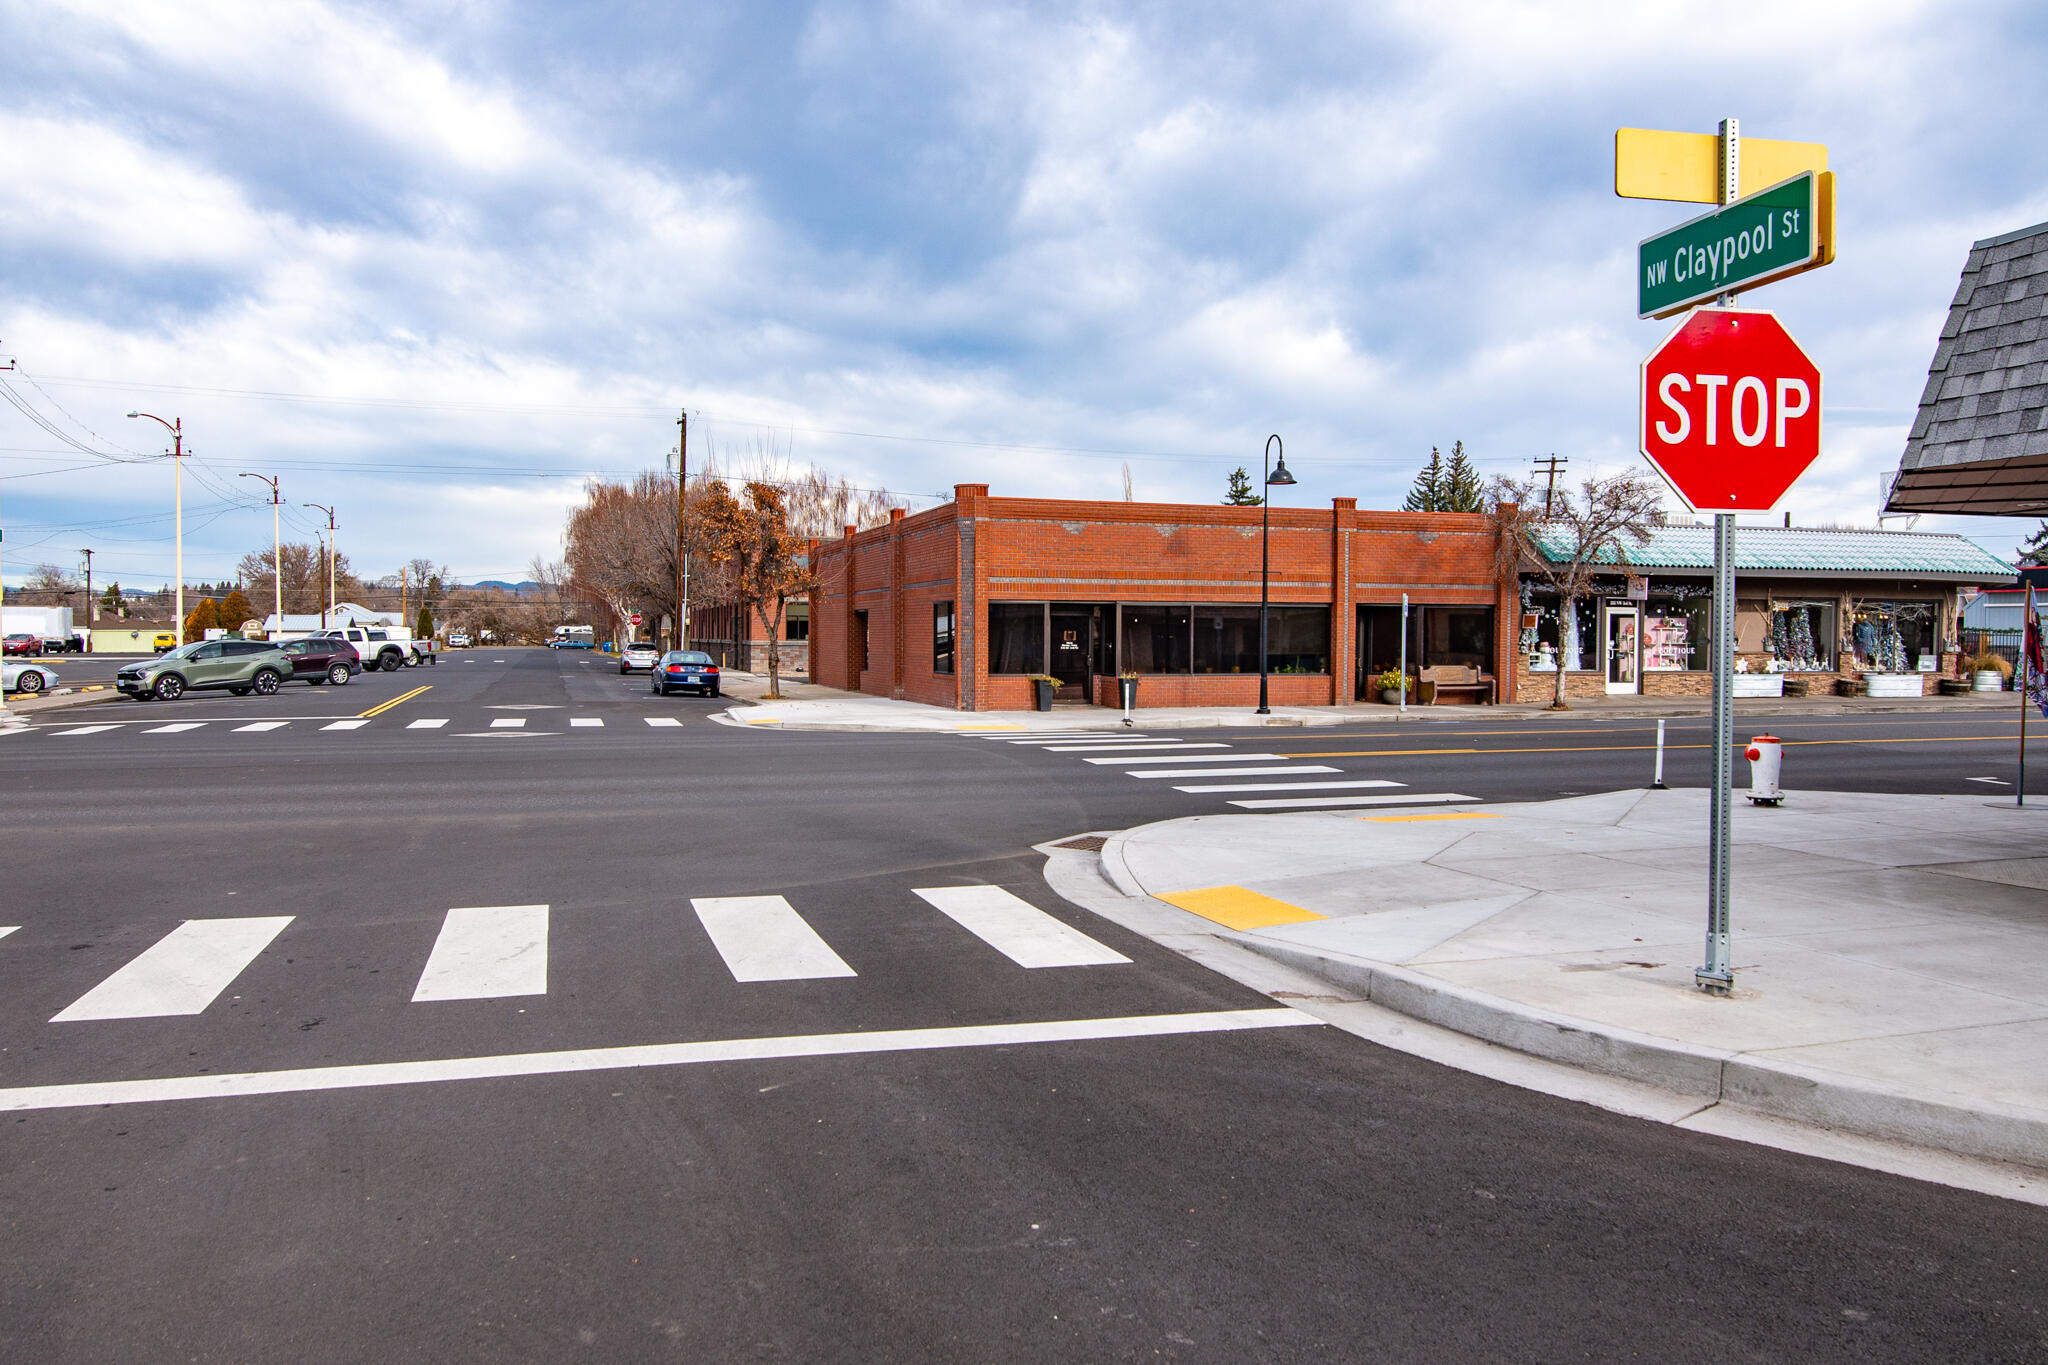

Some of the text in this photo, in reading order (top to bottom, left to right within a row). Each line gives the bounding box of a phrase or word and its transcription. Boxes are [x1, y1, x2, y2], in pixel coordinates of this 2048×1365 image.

[1647, 209, 1800, 289] NW Claypool St
[1655, 372, 1811, 448] STOP
